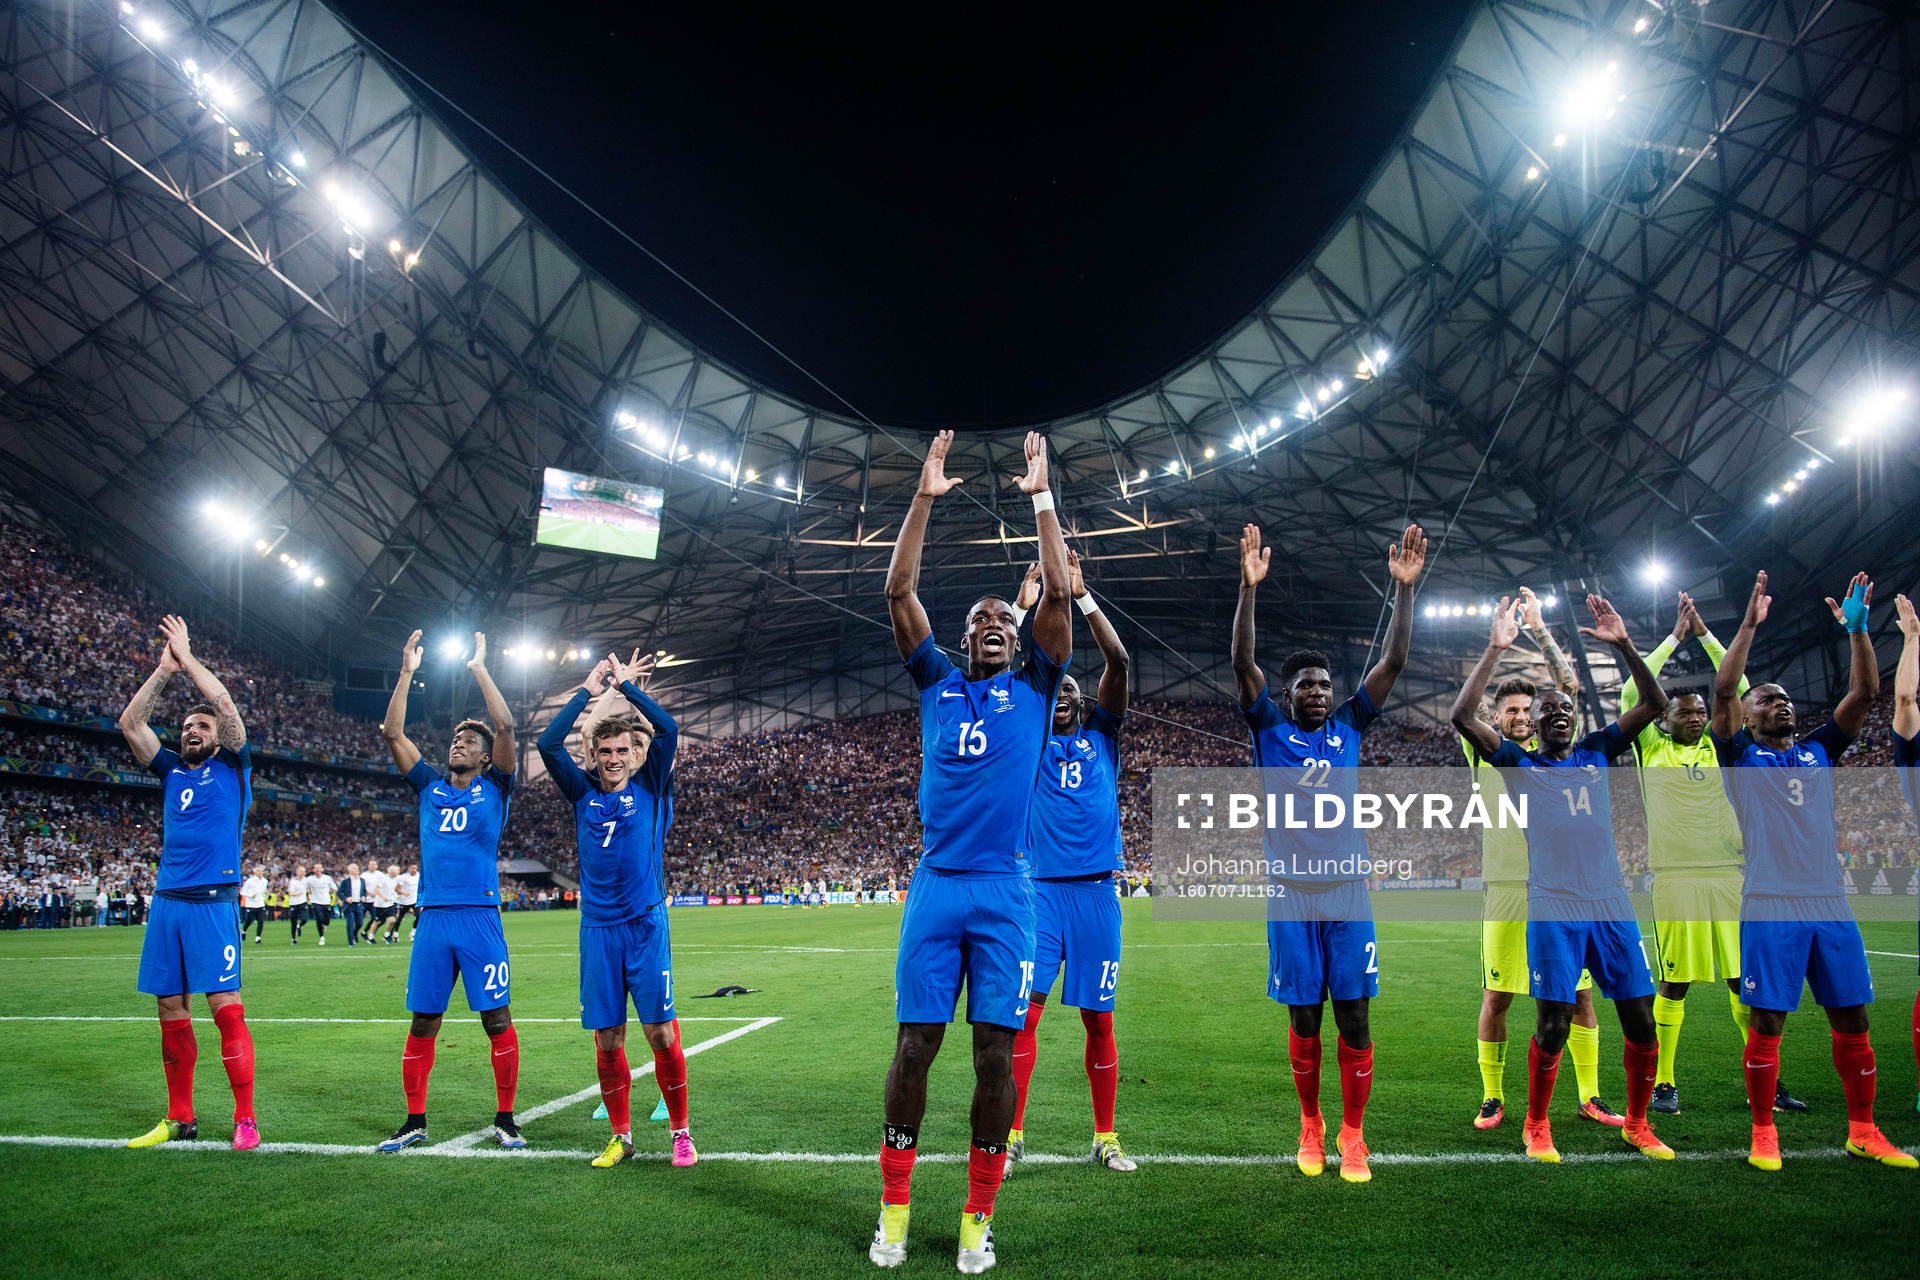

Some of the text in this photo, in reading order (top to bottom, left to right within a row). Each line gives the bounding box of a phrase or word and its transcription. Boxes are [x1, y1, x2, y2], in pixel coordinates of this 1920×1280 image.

[958, 719, 988, 756] 15
[1059, 760, 1083, 789] 13
[1297, 757, 1331, 788] 22
[1681, 761, 1706, 782] 16
[180, 788, 194, 811] 9
[1562, 786, 1593, 817] 14
[1787, 778, 1804, 806] 3
[438, 806, 468, 832] 20
[601, 820, 617, 848] 7
[1384, 881, 1408, 889] UEFA
[1408, 881, 1433, 889] EURO
[223, 944, 236, 971] 9
[483, 961, 510, 991] 20
[1018, 960, 1035, 1000] 15
[1099, 960, 1120, 990] 13
